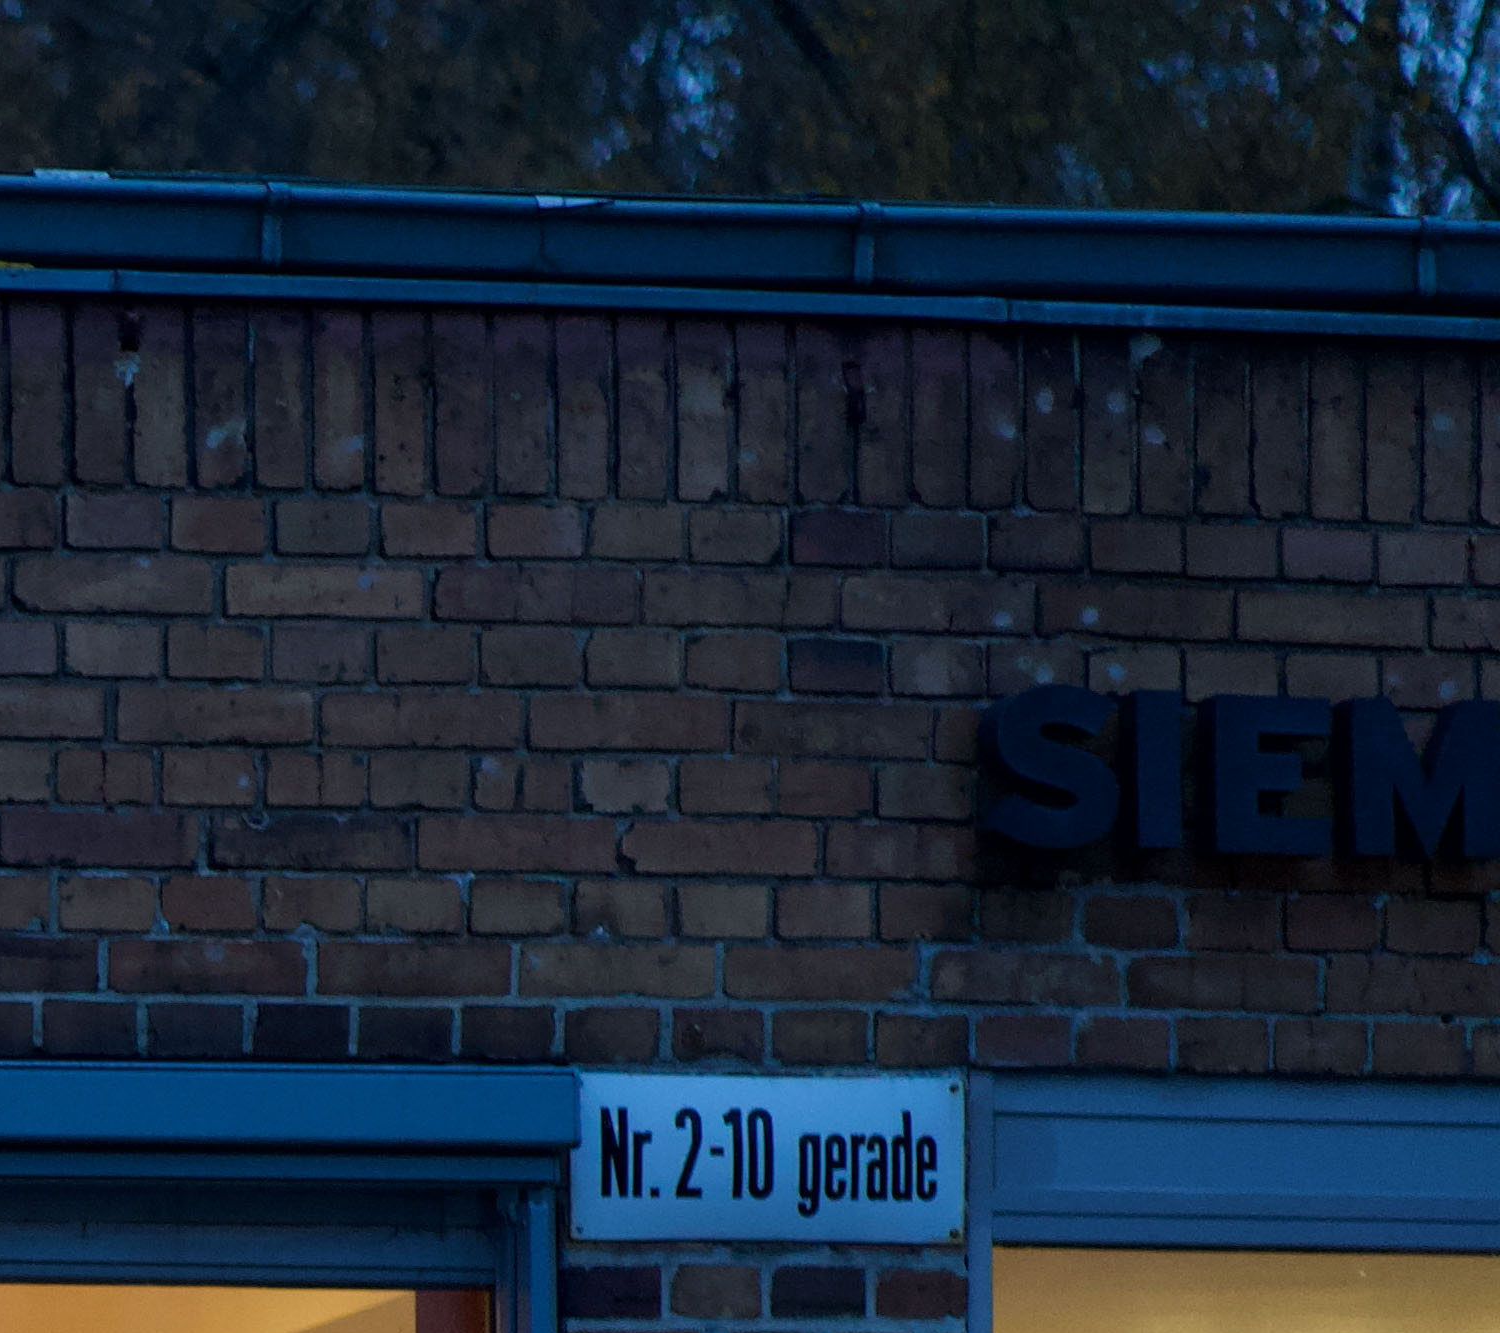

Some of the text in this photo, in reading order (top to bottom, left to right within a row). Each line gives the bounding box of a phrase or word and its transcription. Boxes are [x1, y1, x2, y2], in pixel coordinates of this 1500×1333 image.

[600, 1106, 940, 1218] Nr. 2-10 gerade
